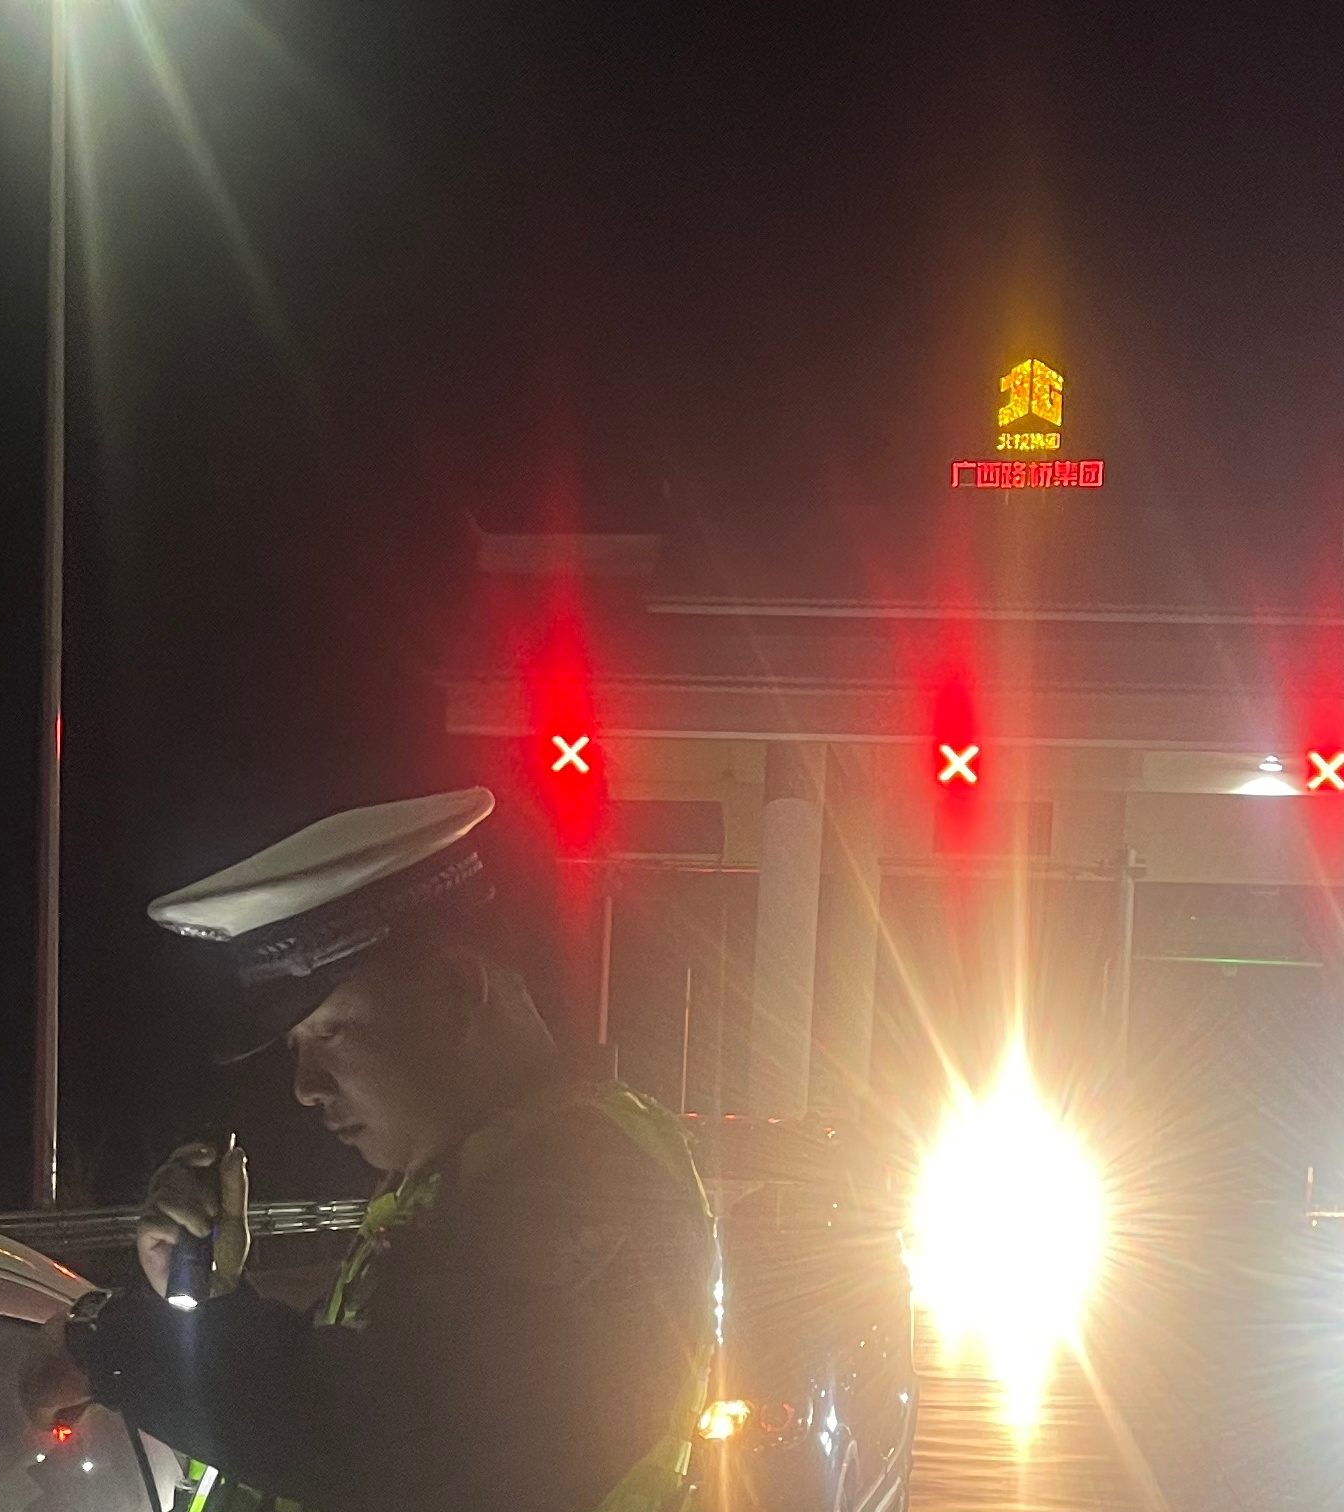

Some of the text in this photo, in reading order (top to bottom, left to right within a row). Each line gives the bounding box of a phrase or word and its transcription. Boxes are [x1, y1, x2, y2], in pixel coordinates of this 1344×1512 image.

[997, 433, 1061, 450] 北投集团
[951, 461, 1104, 488] 广西路桥集团
